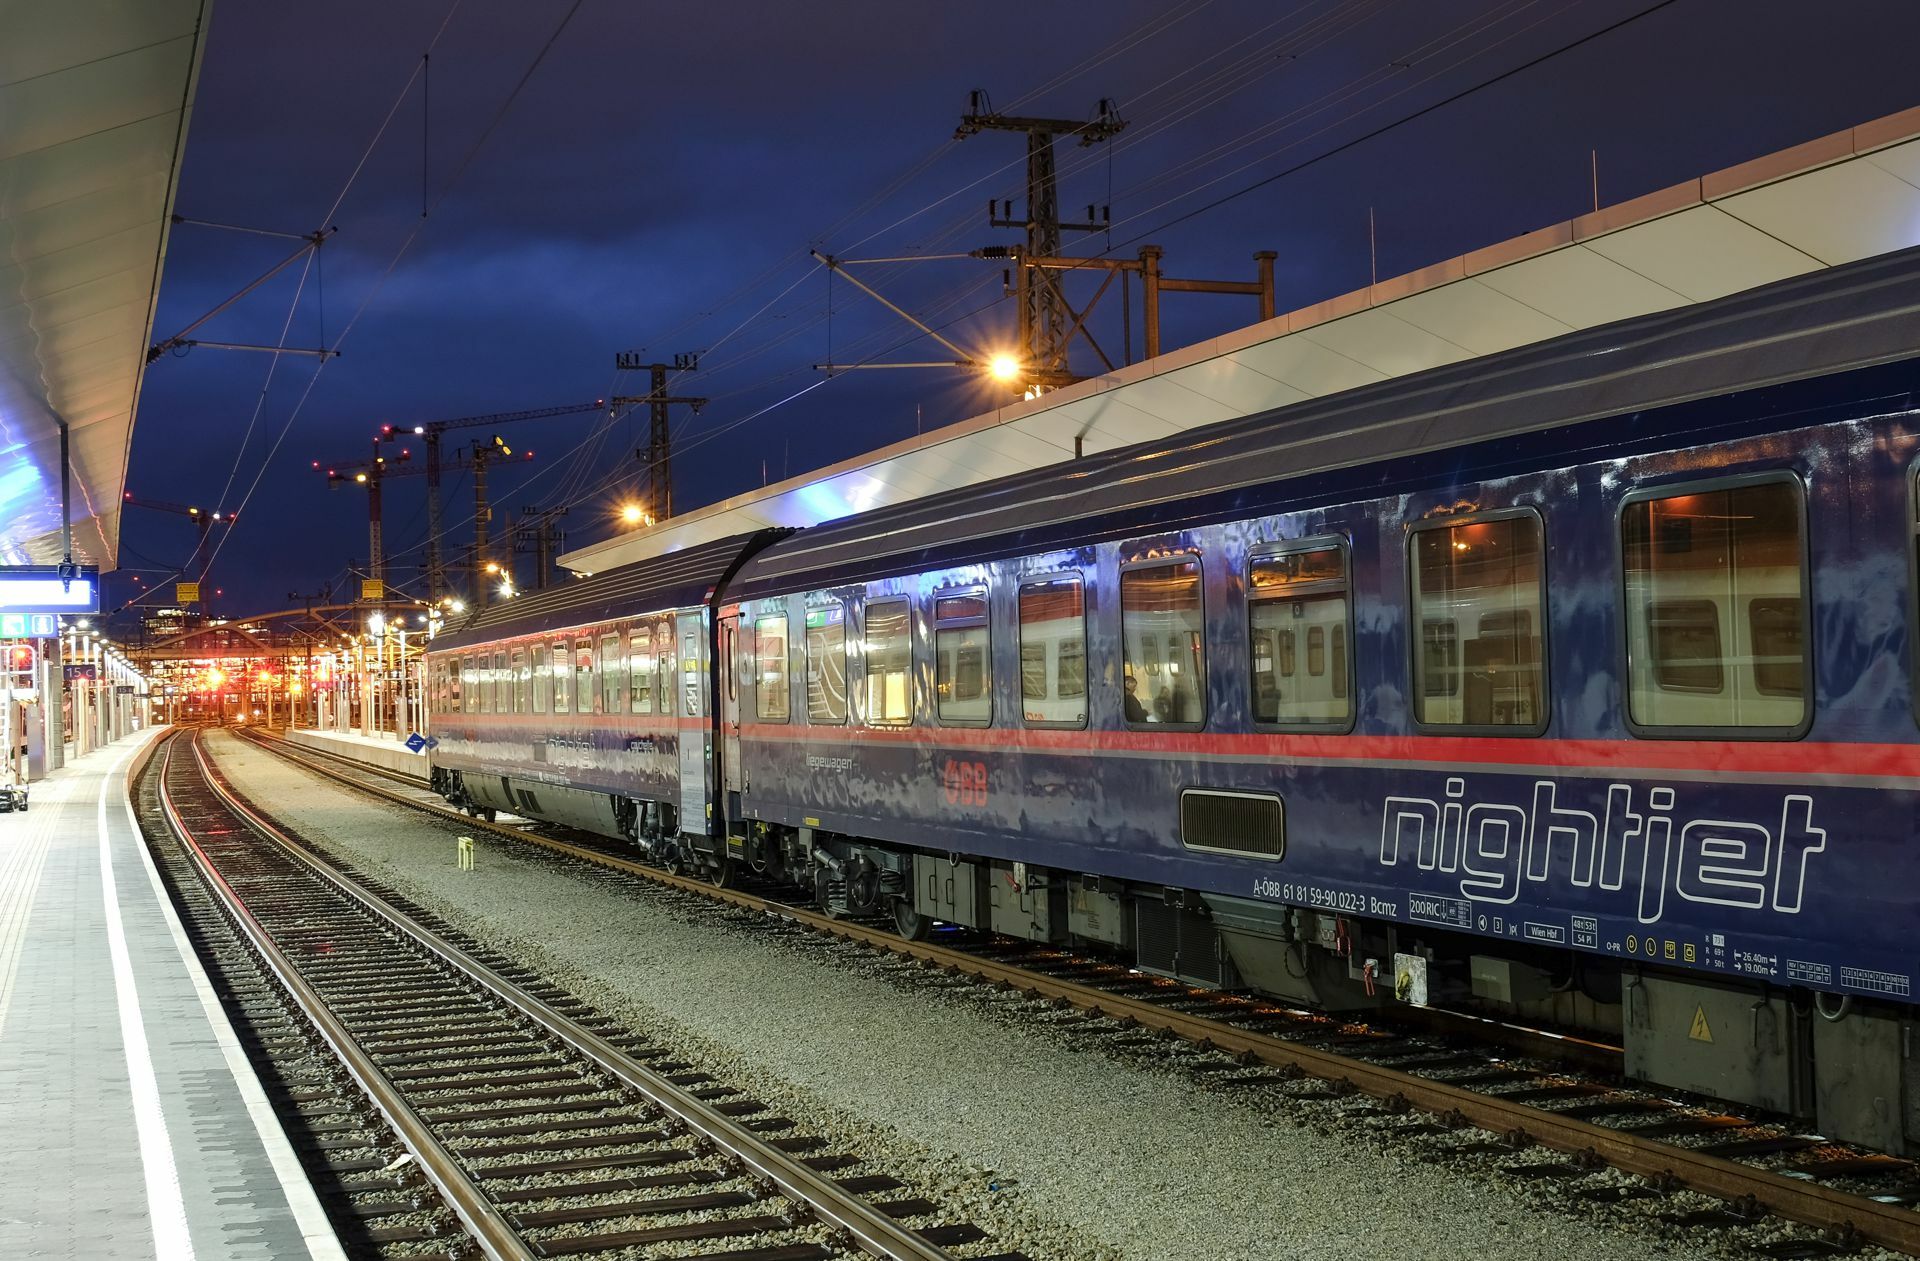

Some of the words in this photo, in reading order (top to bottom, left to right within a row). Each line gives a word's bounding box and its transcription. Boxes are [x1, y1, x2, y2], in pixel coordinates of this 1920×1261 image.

[66, 667, 82, 678] 15
[943, 758, 989, 808] ÖBB
[1380, 777, 1827, 924] nightjet
[1253, 877, 1281, 898] A-ÖBB
[1283, 883, 1295, 900] 61
[1296, 885, 1308, 903] 81
[1310, 887, 1337, 907] 59-90
[1338, 891, 1366, 912] 022-3
[1370, 896, 1398, 917] Bcmz
[1410, 899, 1426, 915] 200
[1426, 901, 1440, 917] RIC
[1530, 926, 1546, 938] Wien
[1546, 928, 1558, 940] Hbf
[1629, 940, 1634, 949] D
[1705, 946, 1710, 954] R
[1705, 958, 1710, 966] P
[1742, 951, 1768, 965] 26.40m
[1744, 962, 1769, 976] 19.00m
